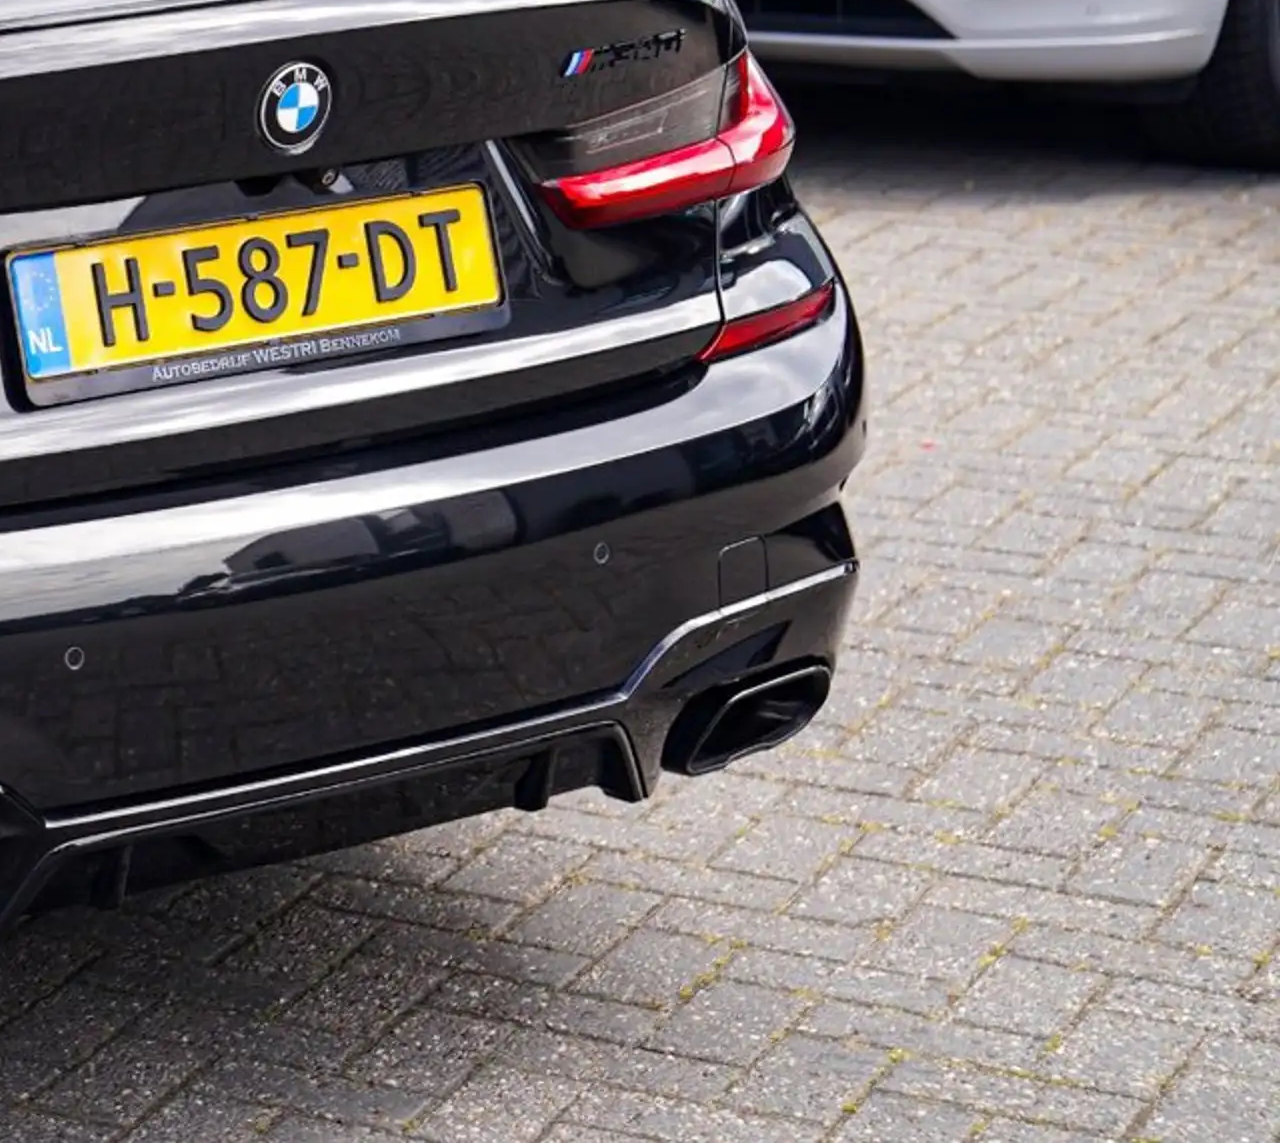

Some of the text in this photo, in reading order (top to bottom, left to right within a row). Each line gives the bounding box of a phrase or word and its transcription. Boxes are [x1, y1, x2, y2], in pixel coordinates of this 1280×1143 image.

[272, 66, 329, 98] BMW
[91, 208, 461, 347] H-587-DT
[28, 327, 64, 354] NL
[151, 328, 402, 382] AUTOBEDRIJF WESTRI BENNEKOM
